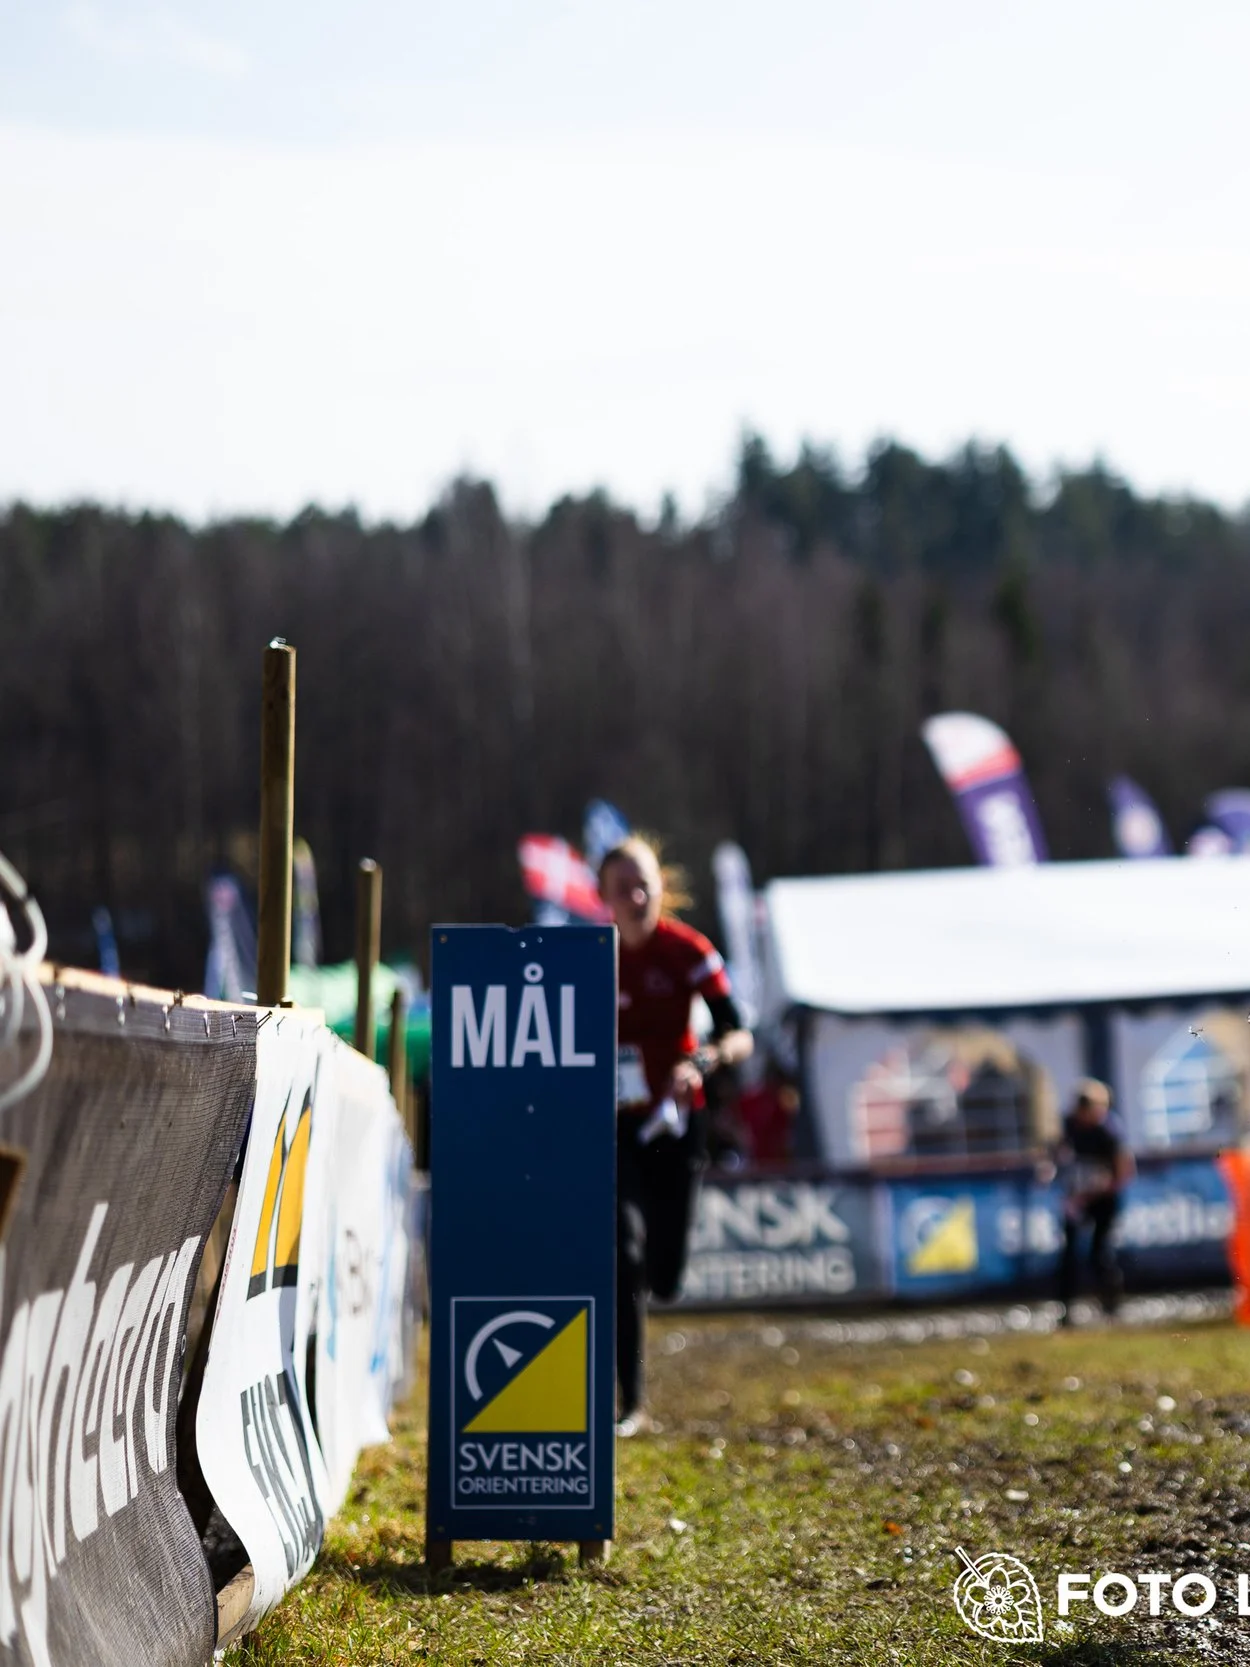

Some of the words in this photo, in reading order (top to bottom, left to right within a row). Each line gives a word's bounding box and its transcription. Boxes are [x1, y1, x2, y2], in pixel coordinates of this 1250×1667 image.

[451, 962, 596, 1068] MÅL
[459, 1442, 588, 1472] SVENSK
[457, 1475, 589, 1495] ORIENTERING
